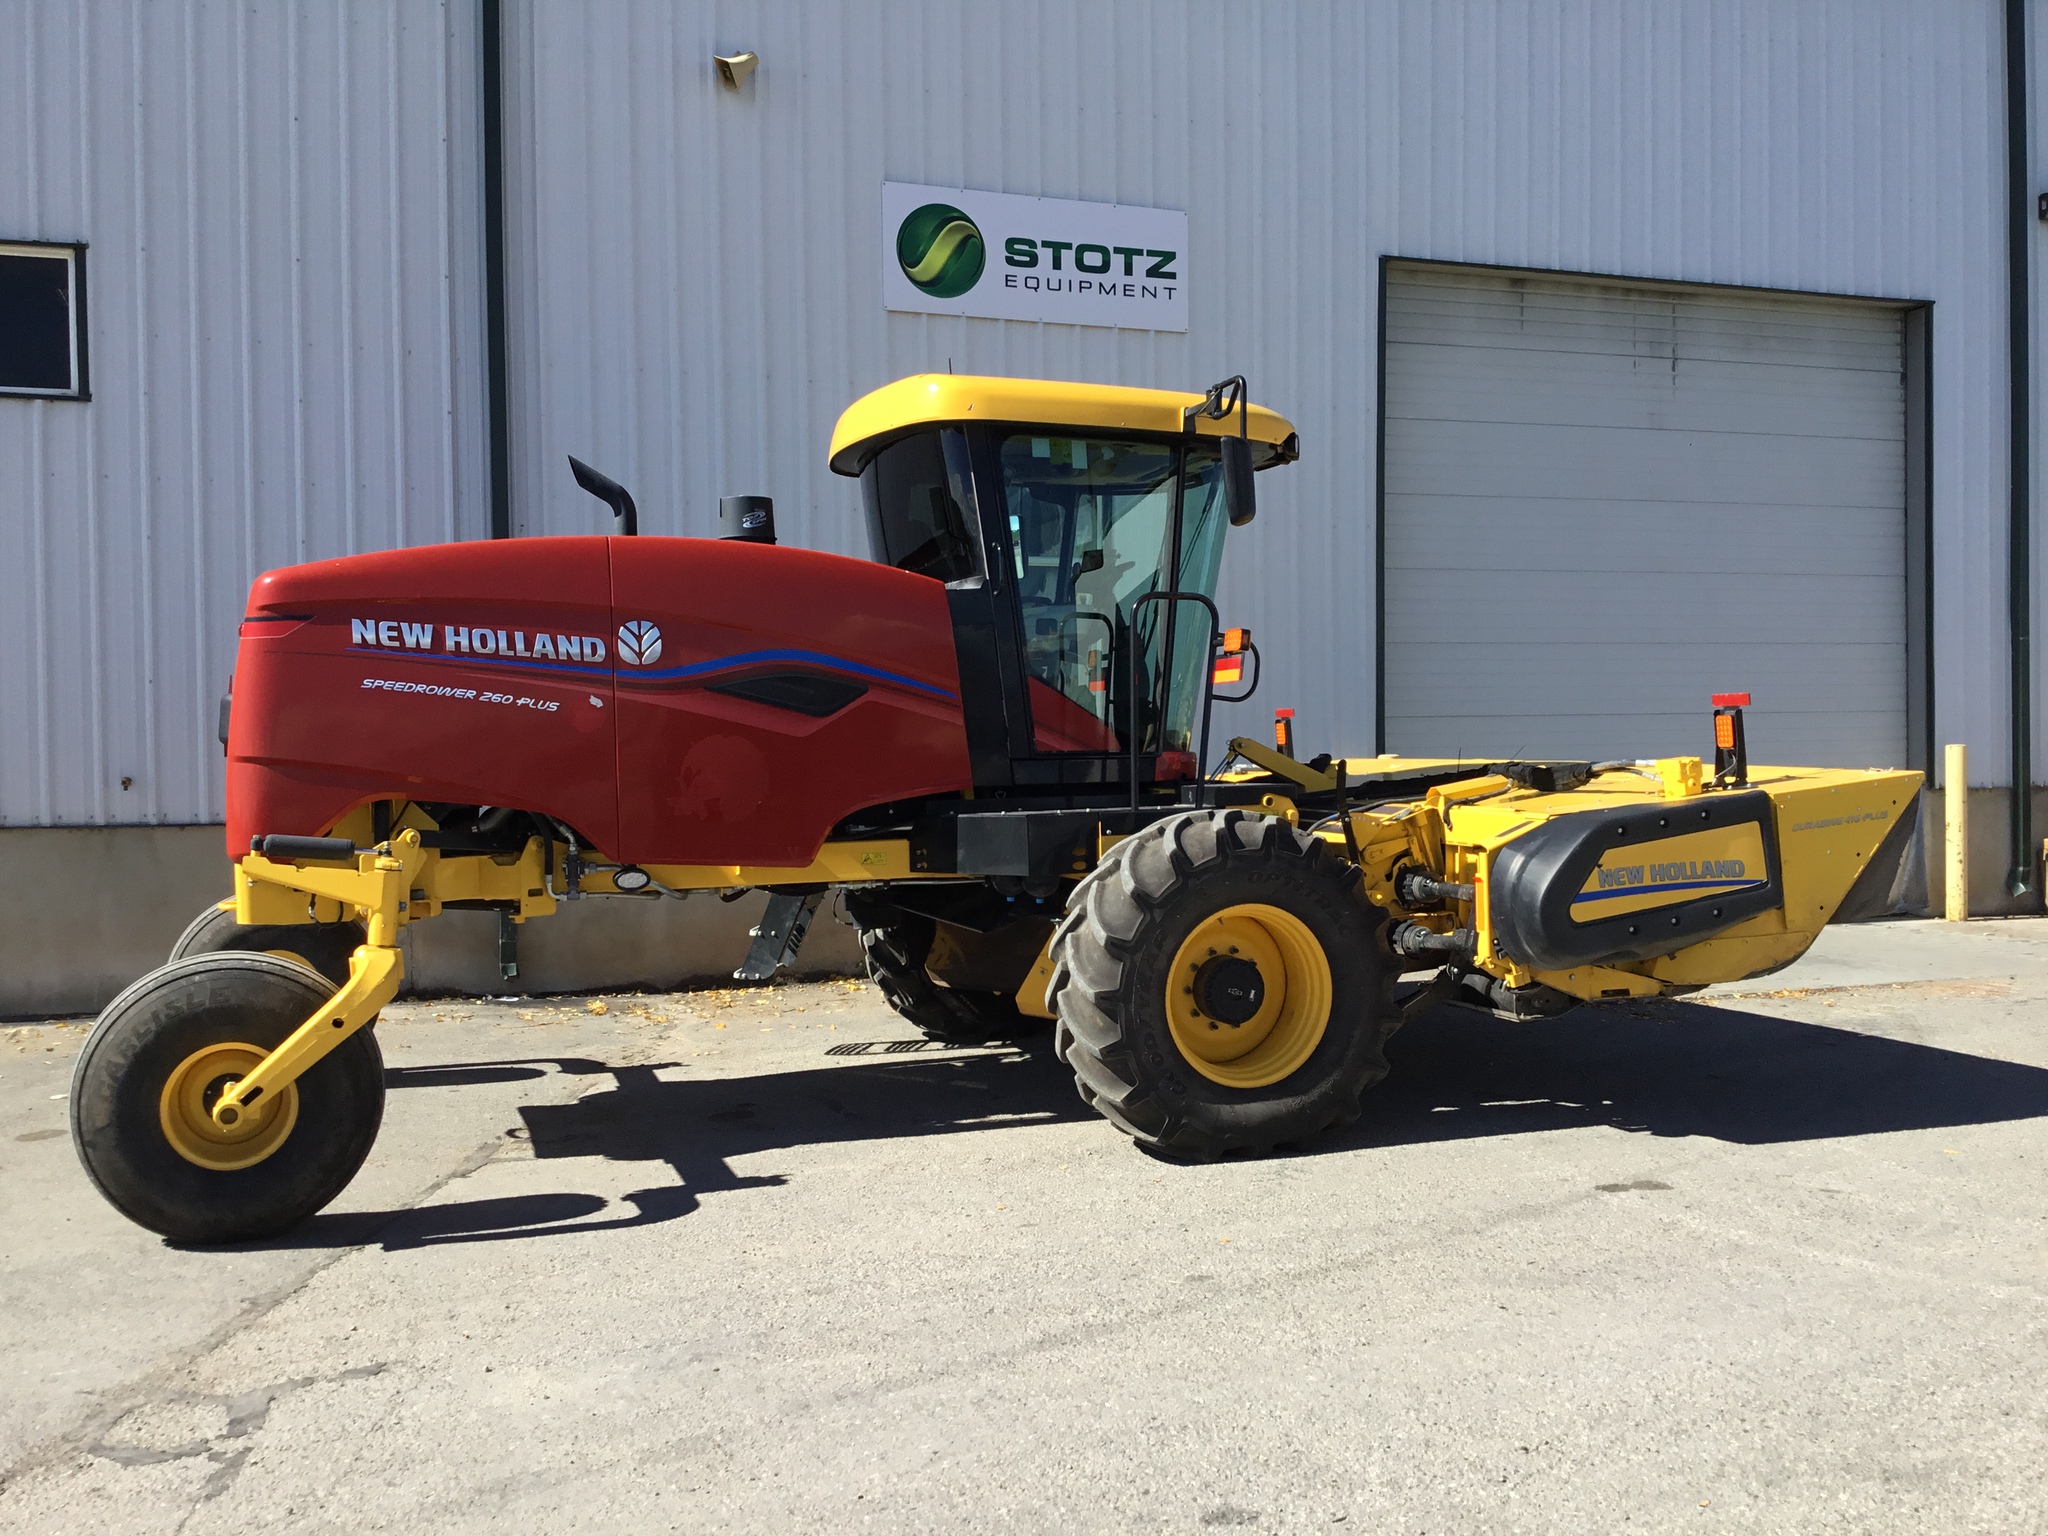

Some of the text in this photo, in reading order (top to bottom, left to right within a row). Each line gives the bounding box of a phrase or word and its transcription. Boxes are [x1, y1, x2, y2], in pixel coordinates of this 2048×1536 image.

[1004, 237, 1177, 280] STOTZ
[1004, 273, 1177, 300] EQUIPMENT
[351, 618, 606, 663] NEW HOLLAND
[361, 678, 477, 700] SPEEDROWER
[478, 691, 514, 705] 260
[1597, 859, 1746, 888] NEW HOLLAND
